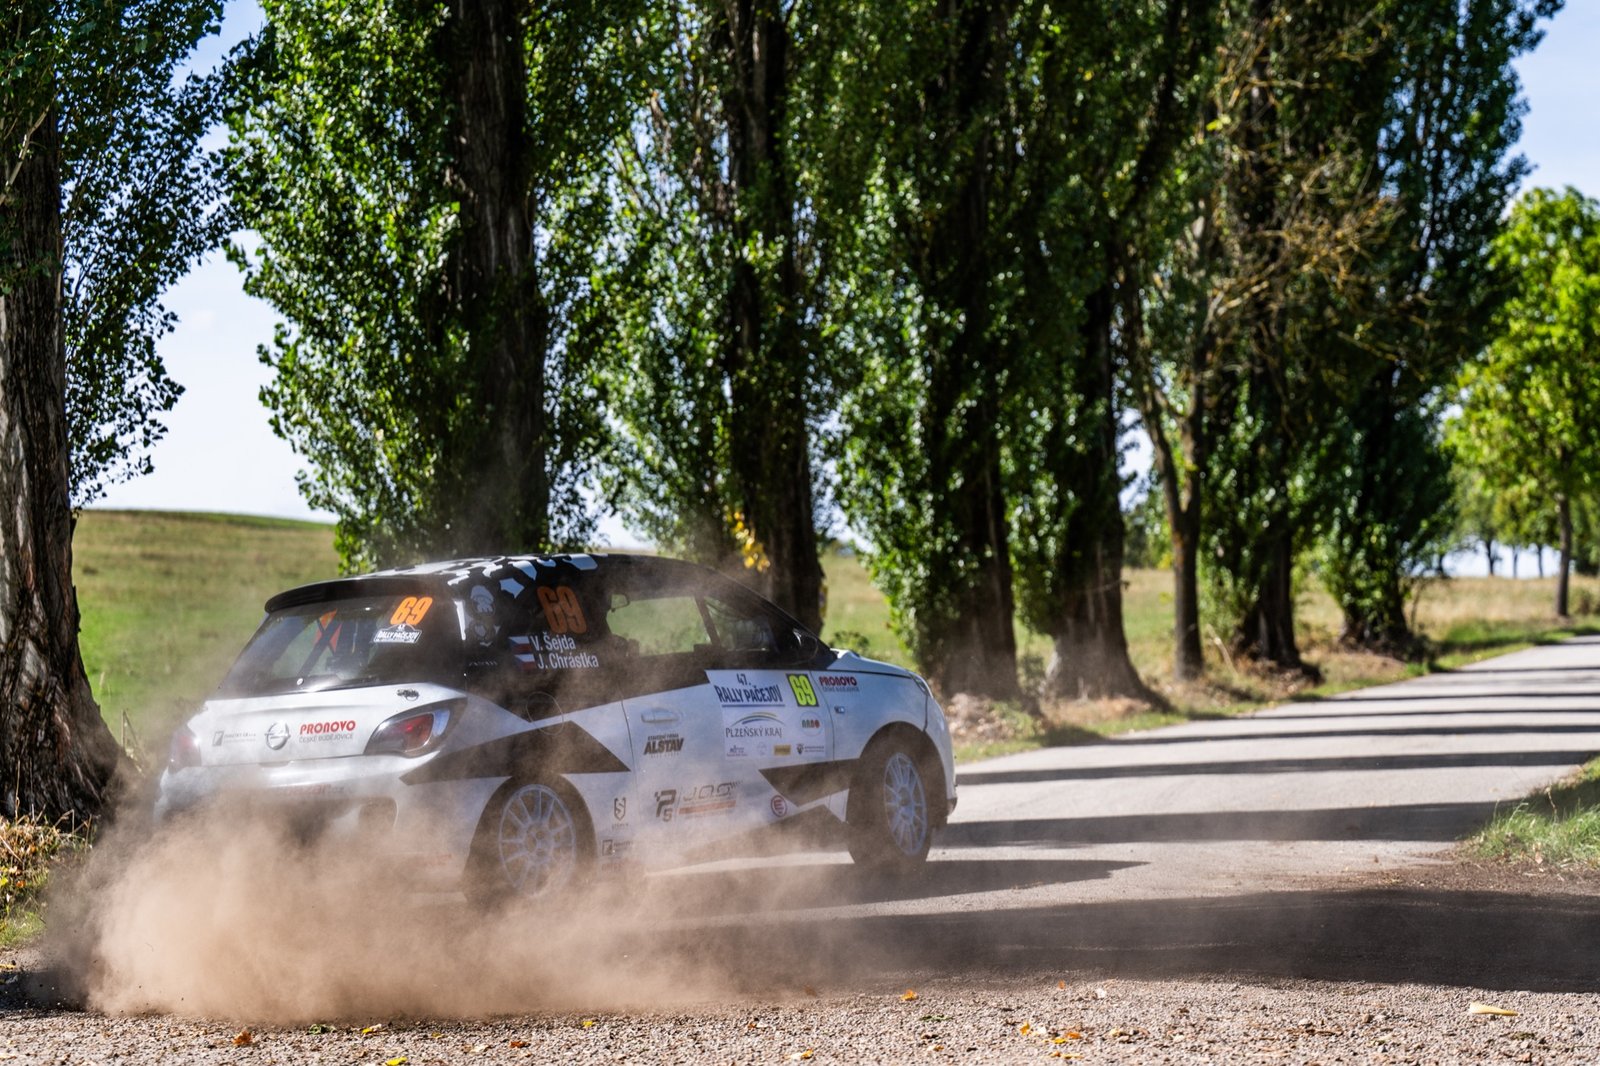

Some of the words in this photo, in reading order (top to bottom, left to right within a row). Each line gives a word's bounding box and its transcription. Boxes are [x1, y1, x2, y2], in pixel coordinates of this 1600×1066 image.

[390, 596, 433, 626] 69
[538, 585, 587, 634] 69
[530, 635, 544, 651] V.
[543, 631, 576, 653] Šejda
[537, 654, 549, 670] J.
[548, 652, 599, 670] Chrástka
[736, 673, 752, 686] 47.
[818, 676, 858, 686] PRONOVO
[714, 685, 744, 702] RALLY
[743, 684, 784, 702] PAČEJOV
[788, 674, 818, 706] 69
[299, 720, 356, 735] PRONOVO
[725, 726, 764, 738] PLZEŇSKÝ
[764, 727, 782, 738] KRAJ
[643, 738, 685, 755] ALSTAV
